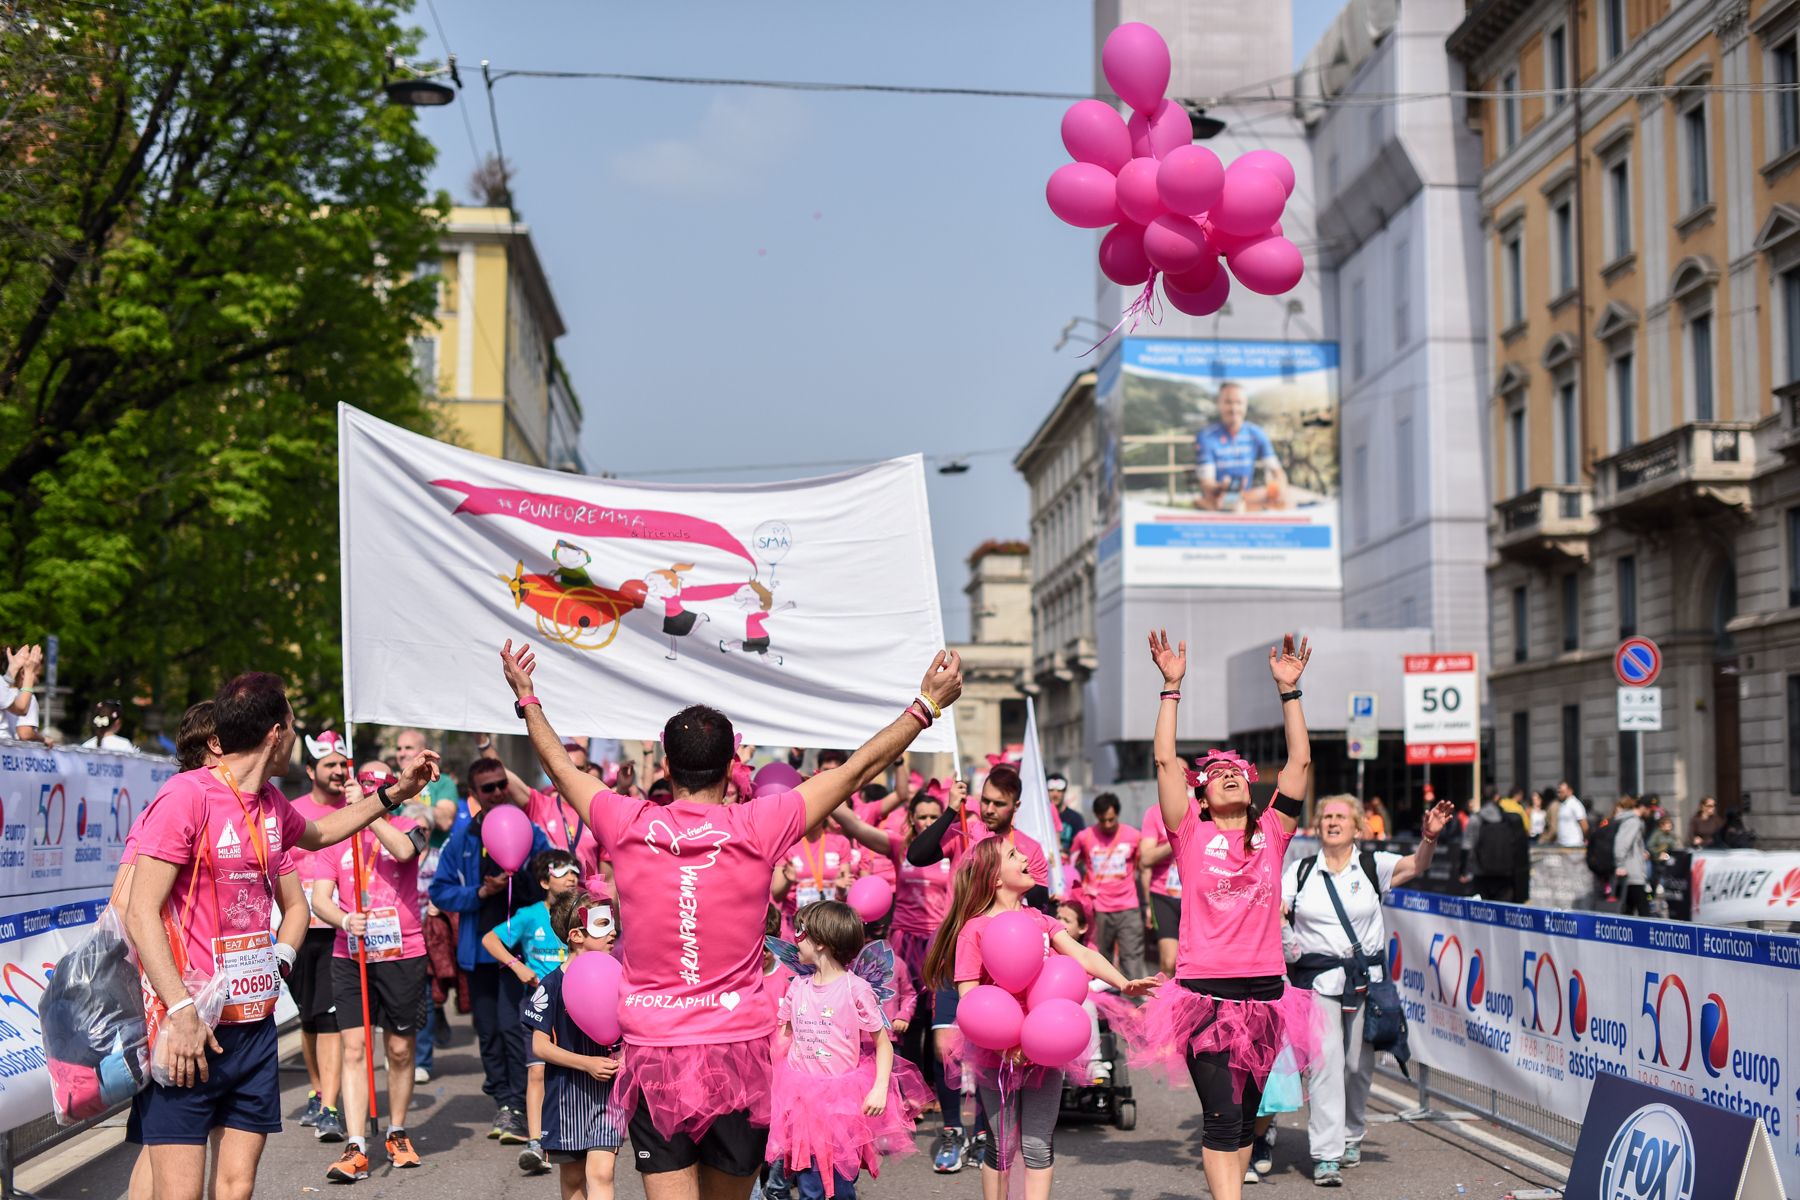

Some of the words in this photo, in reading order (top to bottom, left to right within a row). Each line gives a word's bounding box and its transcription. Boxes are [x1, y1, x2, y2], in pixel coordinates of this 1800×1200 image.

[518, 499, 645, 527] RUNFOREMMA
[642, 528, 691, 539] friends
[758, 537, 789, 548] SMA
[1357, 699, 1370, 713] P
[1423, 687, 1460, 712] 50
[2, 755, 24, 771] RELAY
[25, 756, 58, 773] SPONSOR
[5, 824, 26, 846] europ
[687, 821, 713, 838] friends
[218, 848, 242, 856] MILANO
[1702, 870, 1773, 904] HUAWEI
[1403, 892, 1430, 912] #corricon
[678, 866, 700, 986] #RUNFOREMMA
[1505, 907, 1533, 929] #corricon
[1544, 913, 1577, 935] #corricon
[1595, 919, 1633, 943] #corricon
[1649, 925, 1690, 950] #corricon
[225, 940, 242, 950] EA7
[1704, 932, 1753, 958] #corricon
[240, 959, 266, 967] MARATHON
[1429, 933, 1463, 1008] 50
[231, 974, 273, 997] 2069D
[1403, 968, 1425, 997] europ
[1522, 950, 1562, 1037] 50
[243, 1001, 266, 1015] EA7
[625, 993, 719, 1009] #FORZAPHIL
[1486, 990, 1513, 1023] europ
[1638, 971, 1693, 1072] 50
[1465, 1016, 1511, 1054] assistance
[1590, 1016, 1627, 1056] europ
[1520, 1036, 1538, 1058] 1968
[1546, 1043, 1564, 1066] 2018
[1522, 1059, 1539, 1072] PROVA
[1540, 1061, 1546, 1073] DI
[1547, 1065, 1565, 1082] FUTURO
[1732, 1049, 1780, 1096] europ
[1618, 1129, 1681, 1200] FOX
